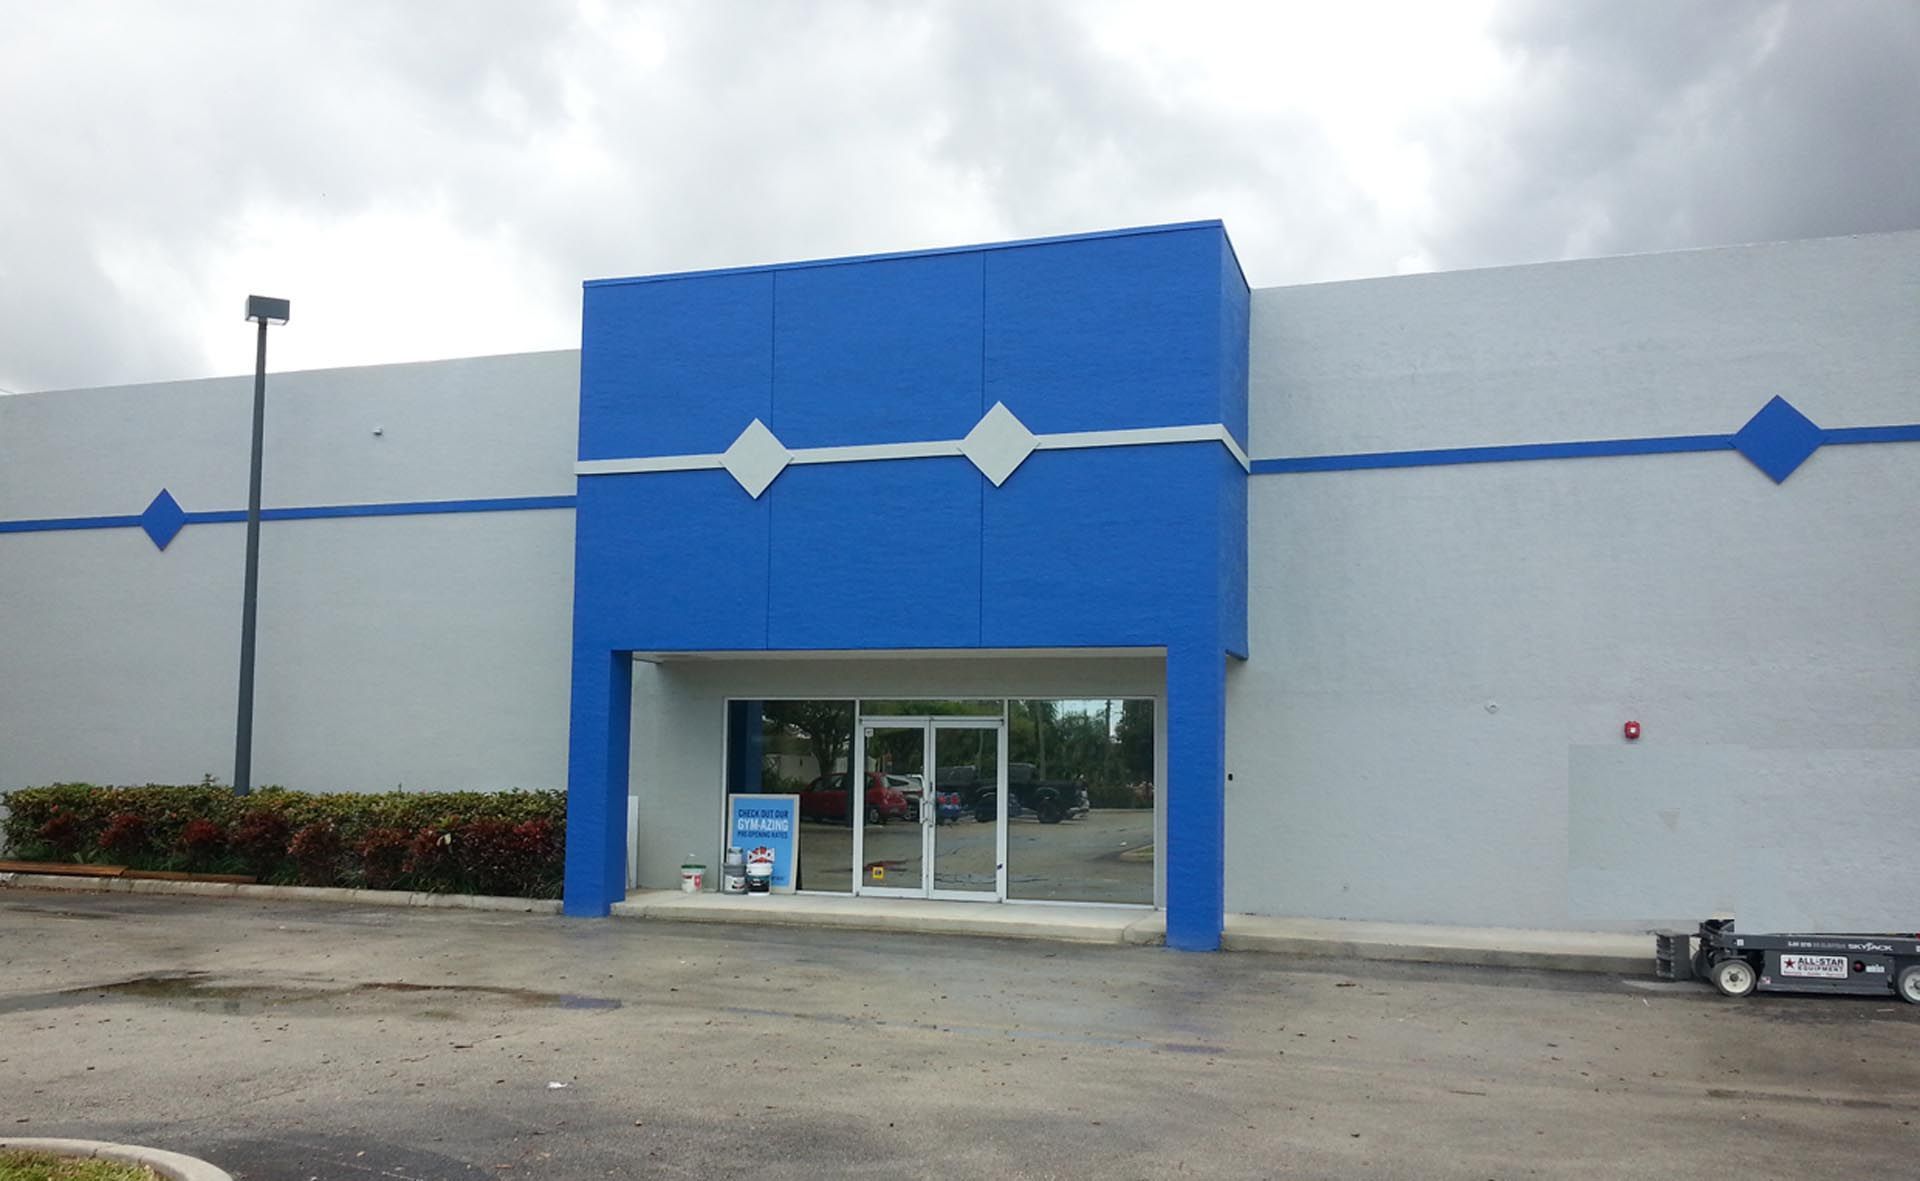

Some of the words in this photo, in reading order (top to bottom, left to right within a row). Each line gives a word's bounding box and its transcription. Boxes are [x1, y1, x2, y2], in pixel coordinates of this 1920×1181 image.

[738, 809, 760, 818] CHECK
[760, 809, 774, 818] OUT
[774, 810, 789, 819] OUR
[737, 817, 789, 831] GYM-AZING
[1848, 942, 1893, 951] SKYJACK
[1797, 957, 1844, 967] ALL-STAR
